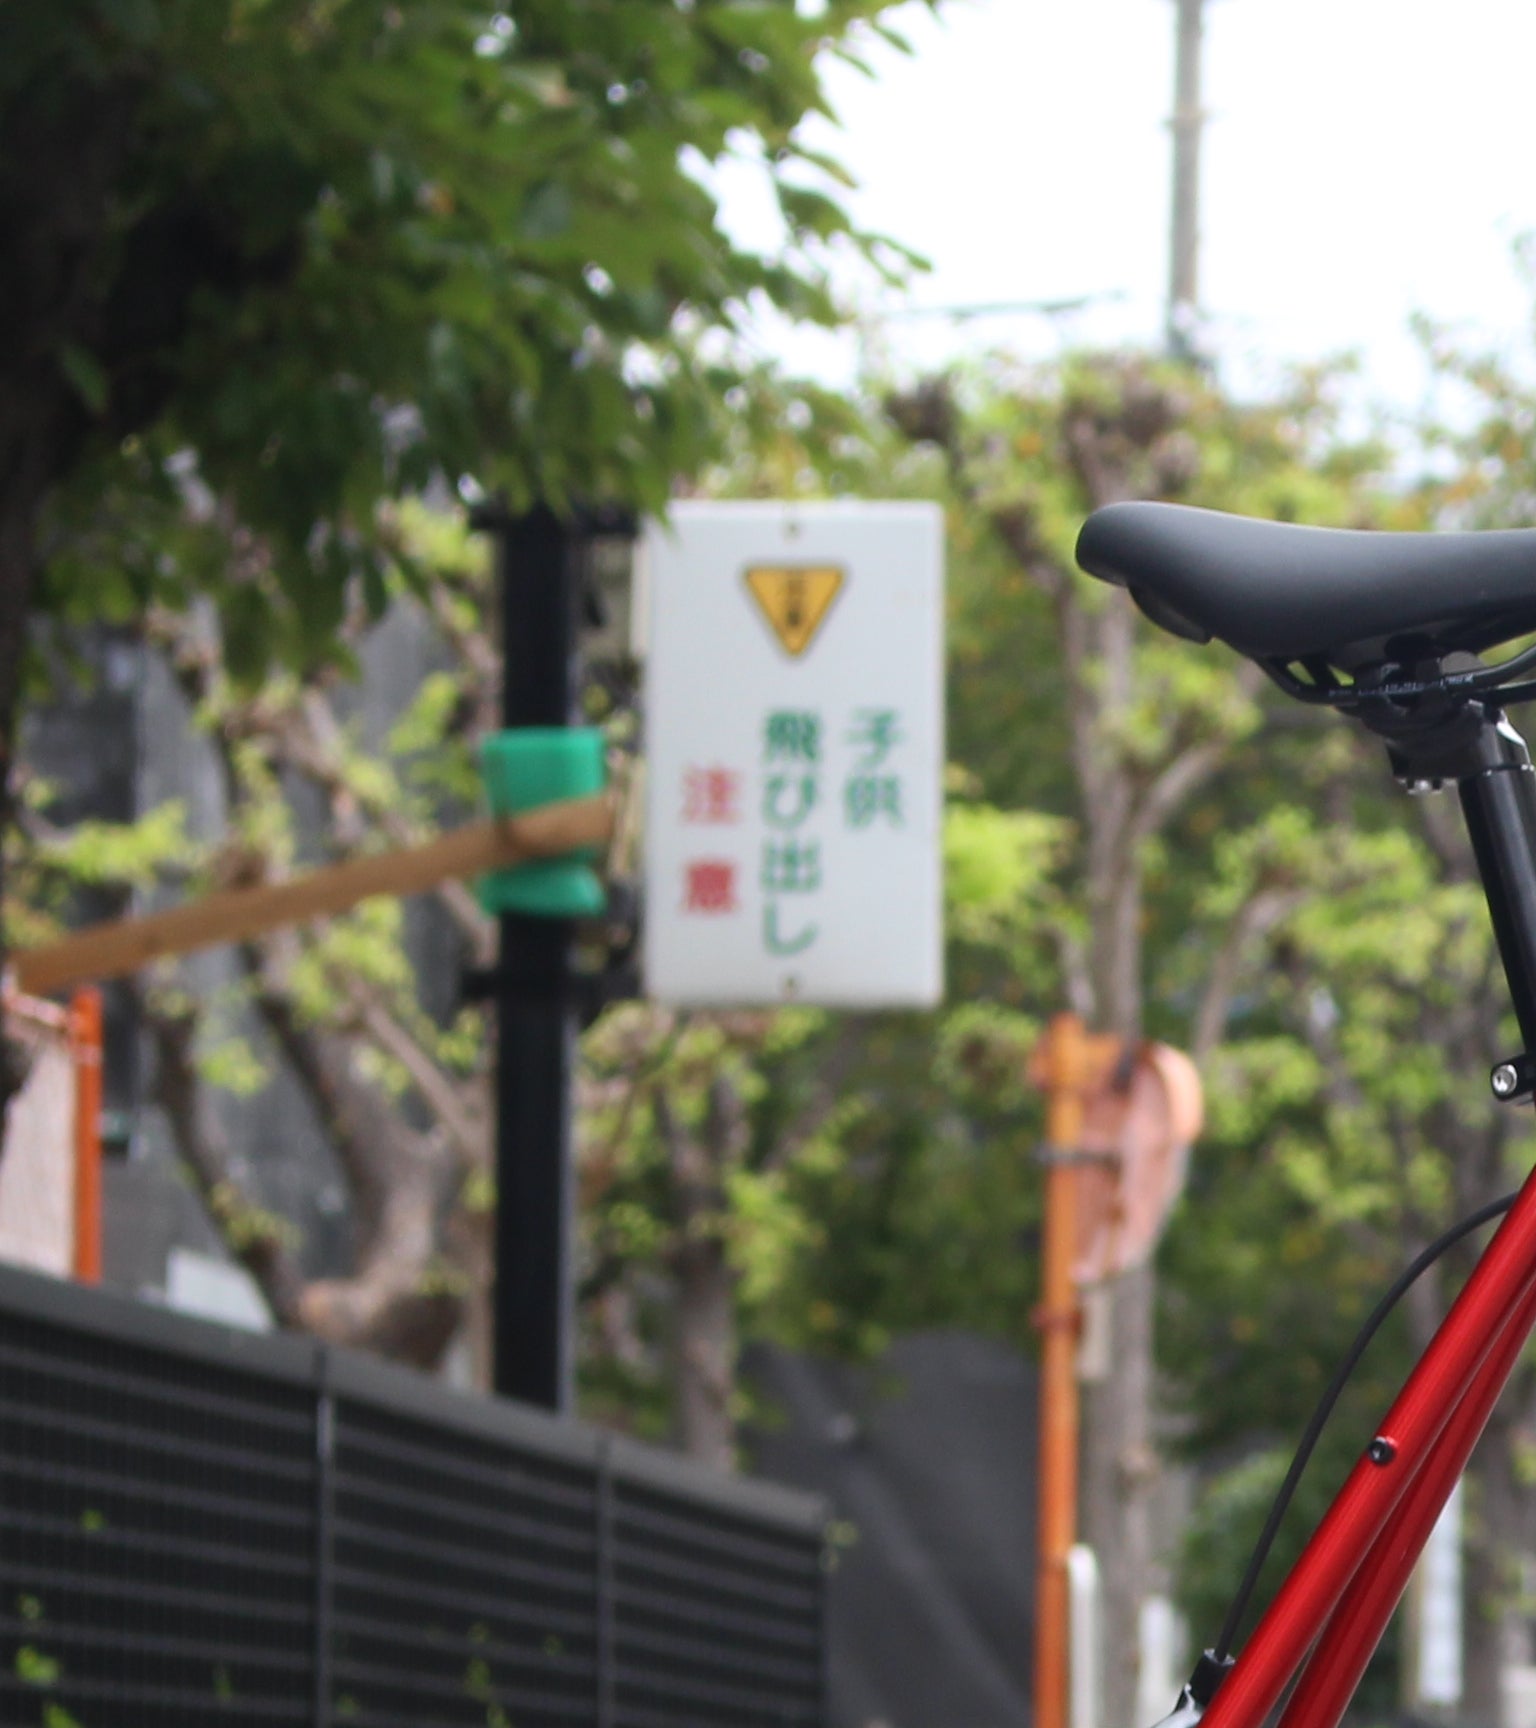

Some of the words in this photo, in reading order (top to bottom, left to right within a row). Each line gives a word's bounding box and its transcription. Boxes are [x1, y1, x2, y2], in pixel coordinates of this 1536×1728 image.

[761, 708, 821, 957] 飛び出し
[845, 708, 904, 831] 子供
